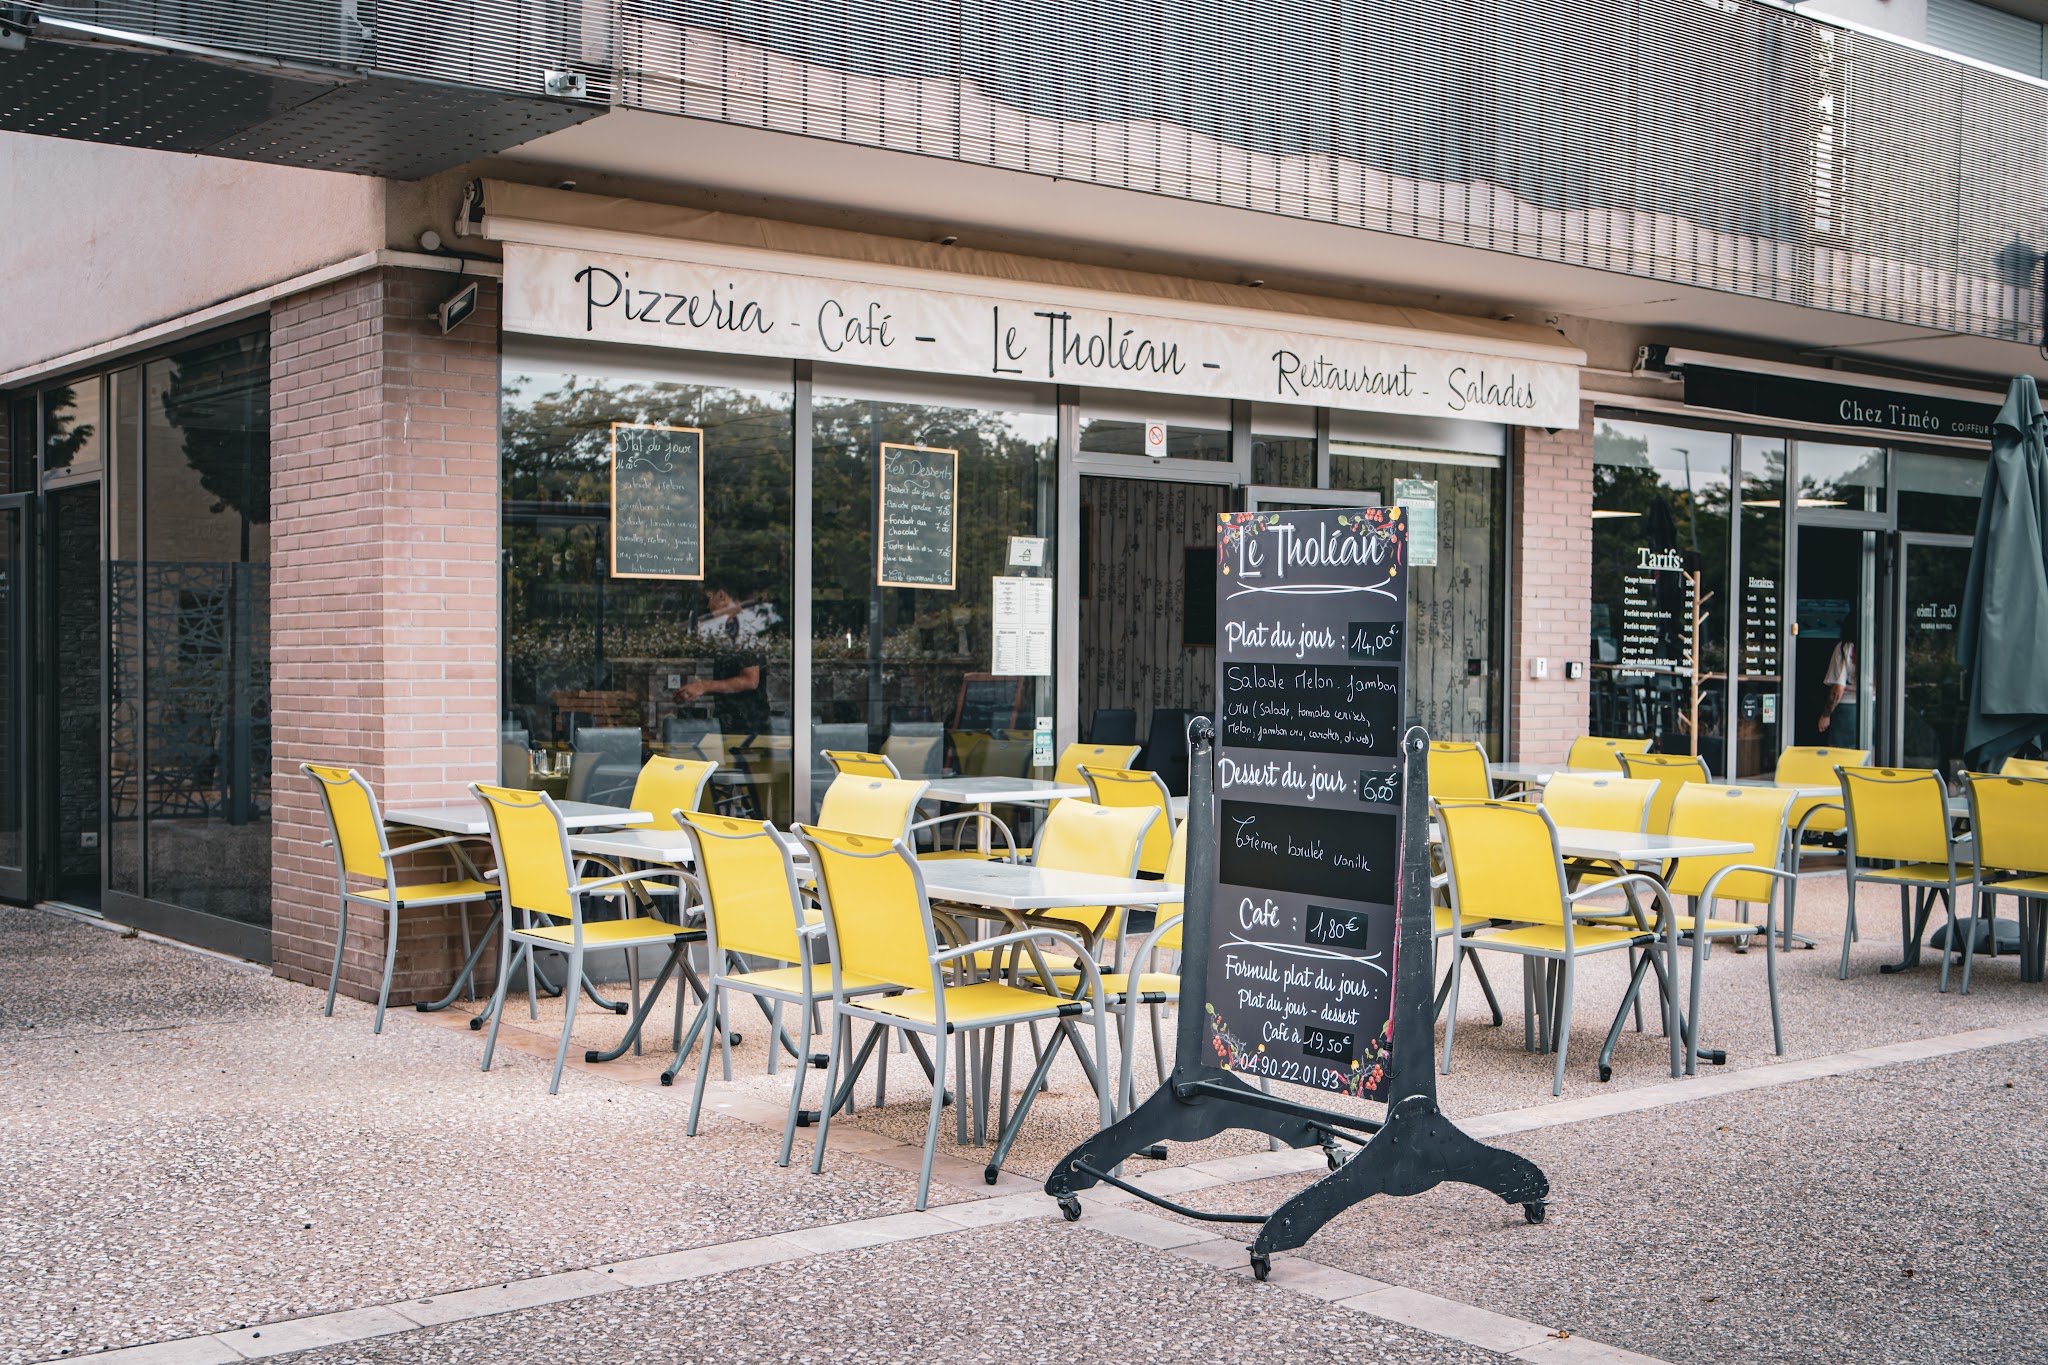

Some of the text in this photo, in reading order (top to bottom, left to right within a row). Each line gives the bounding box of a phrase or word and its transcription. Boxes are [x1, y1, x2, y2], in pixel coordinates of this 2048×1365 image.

[574, 265, 774, 334] Pizzeria
[818, 299, 896, 353] Café
[993, 306, 1027, 374] Le
[1034, 311, 1186, 378] Tholéan
[1272, 350, 1418, 397] Restaurant
[1447, 367, 1537, 410] Salades
[1839, 399, 1989, 435] Chez Timéo COIFFEUR
[648, 437, 661, 452] du
[885, 451, 952, 480] Les Desserts
[1239, 525, 1264, 577] Le
[1267, 522, 1385, 577] Tholéan
[1225, 621, 1269, 653] Plat
[1270, 621, 1296, 647] du
[1296, 622, 1335, 659] jour
[1227, 664, 1284, 691] Salade
[1294, 666, 1333, 690] Melon
[1218, 757, 1281, 790] Dessert
[1281, 761, 1307, 789] du
[1306, 765, 1347, 801] jour
[1239, 897, 1281, 931] Café
[1225, 954, 1281, 983] Formule
[1283, 963, 1315, 992] plat
[1314, 968, 1336, 992] du
[1335, 973, 1370, 1002] jour
[1238, 988, 1266, 1009] Plat
[1266, 993, 1283, 1012] du
[1282, 997, 1308, 1020] jour
[1320, 1003, 1360, 1026] dessert
[1262, 1021, 1291, 1043] Café
[1291, 1027, 1301, 1044] à
[1240, 1052, 1340, 1090] 04.90.22.01.93
